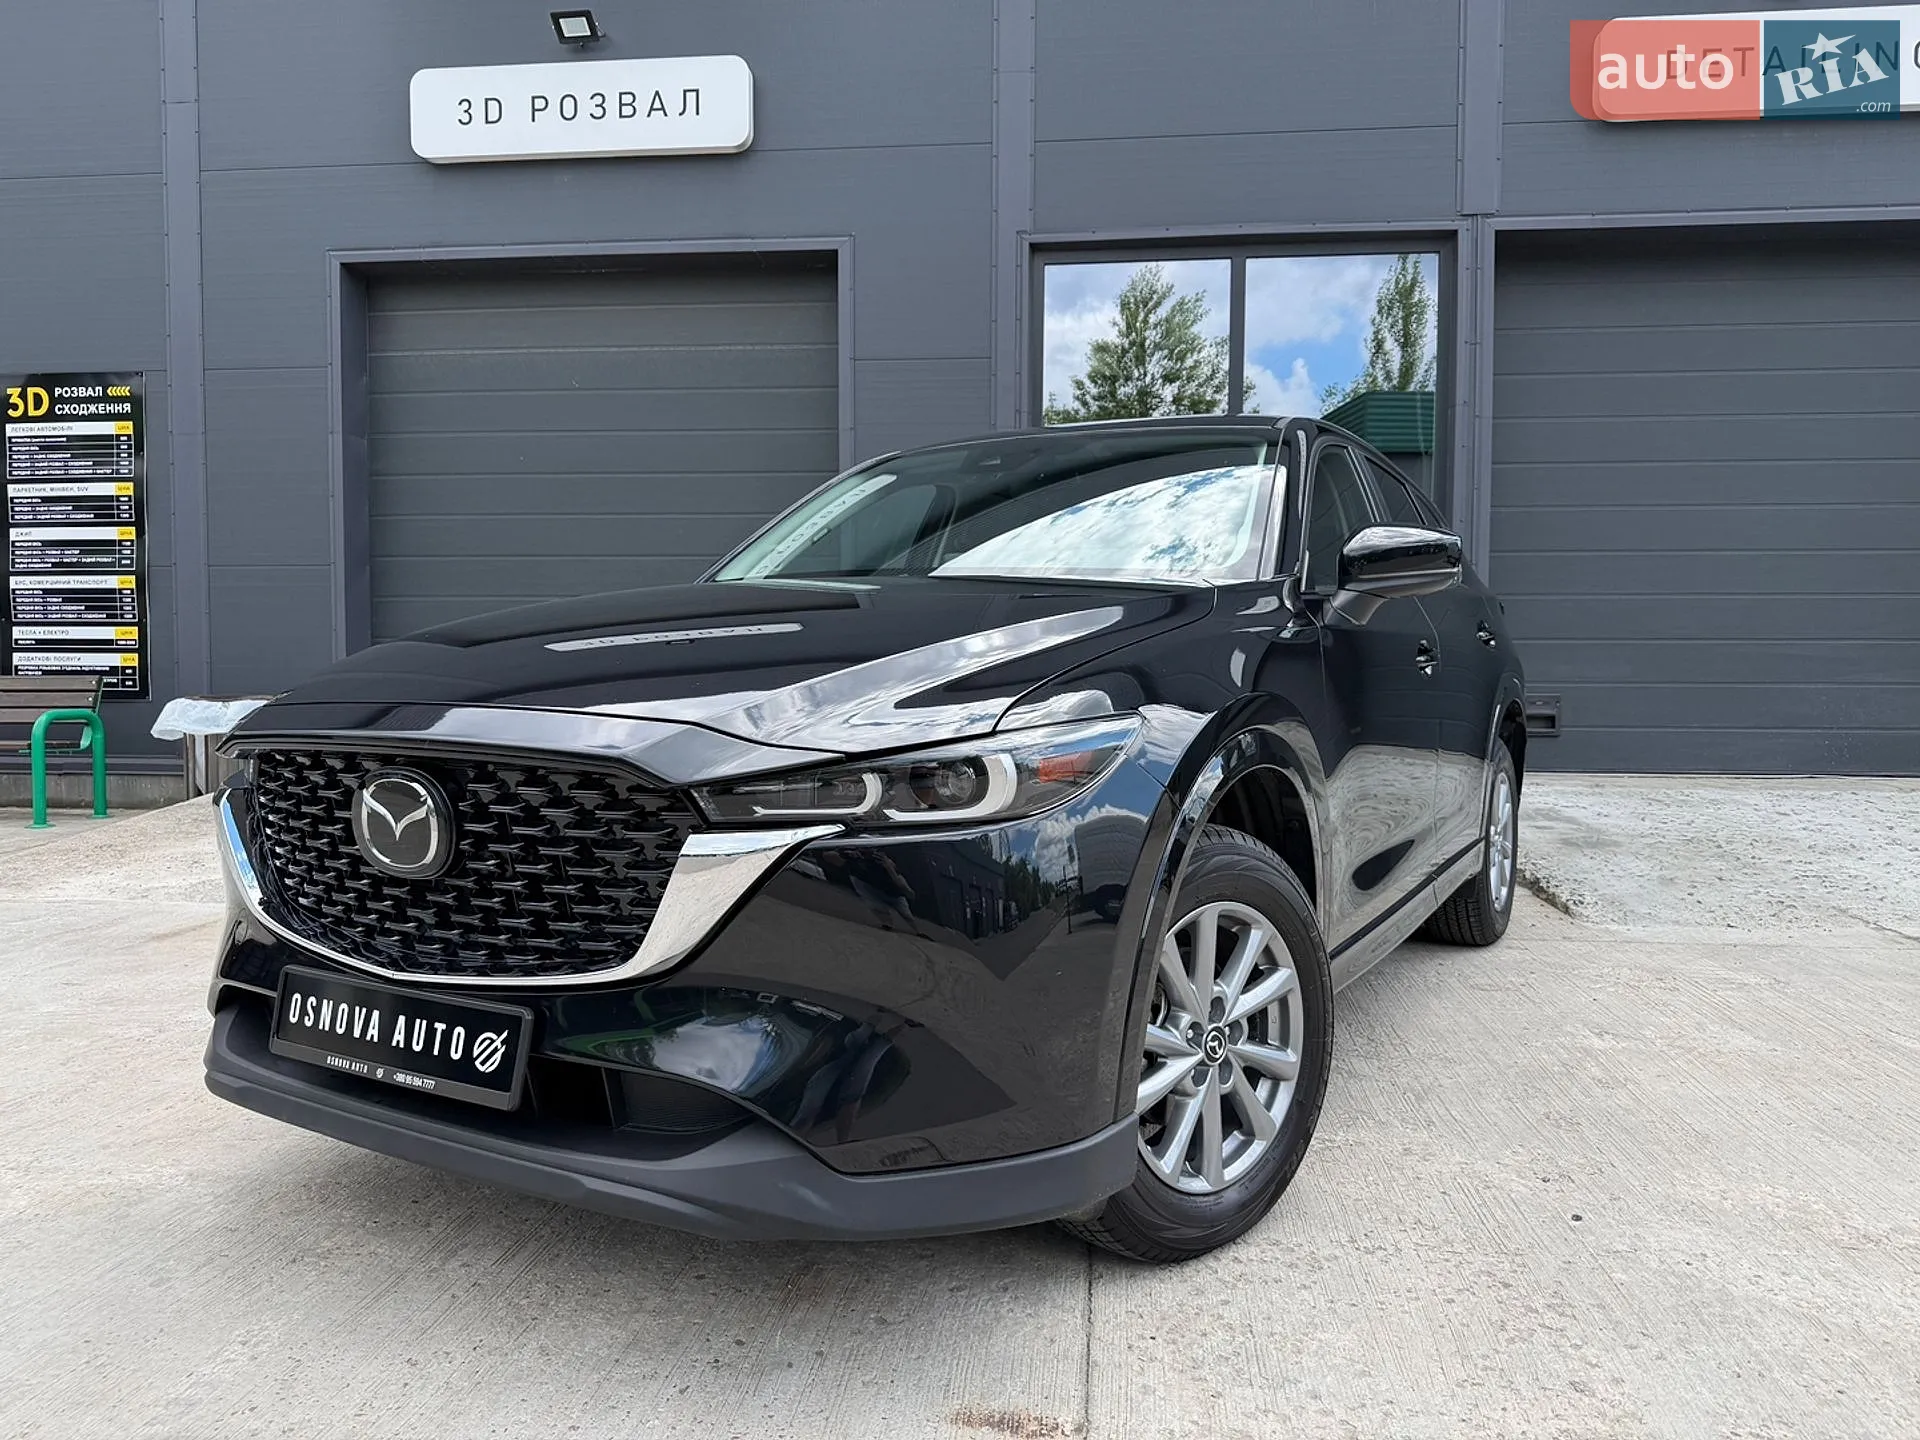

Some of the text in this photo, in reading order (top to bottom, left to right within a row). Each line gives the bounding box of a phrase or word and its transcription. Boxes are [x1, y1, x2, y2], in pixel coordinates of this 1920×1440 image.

[457, 87, 701, 125] 3D РОЗВАЛ
[7, 386, 103, 418] 3D РОЗВАЛ
[54, 402, 131, 416] СХОДЖЕННЯ
[288, 992, 466, 1060] OSNOVA AUTO
